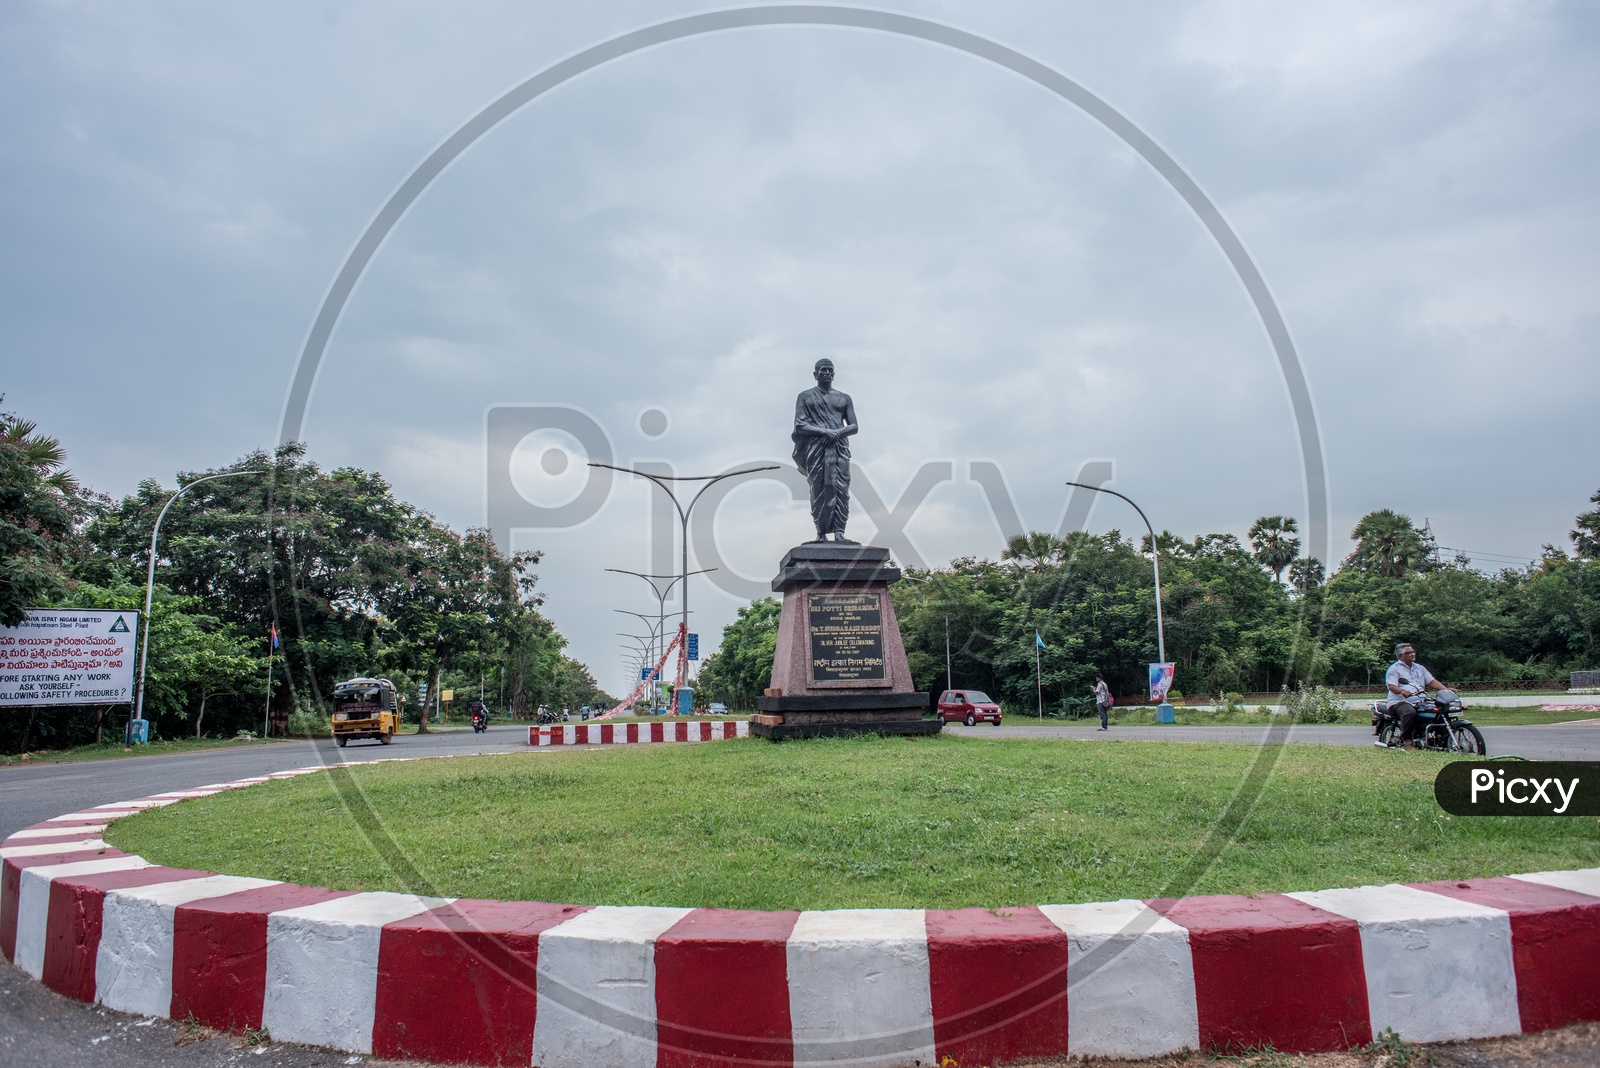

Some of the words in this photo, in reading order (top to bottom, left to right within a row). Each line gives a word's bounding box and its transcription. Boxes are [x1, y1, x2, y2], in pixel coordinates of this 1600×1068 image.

[21, 674, 60, 682] STARTING
[63, 674, 83, 682] ANY
[87, 673, 112, 681] WORK
[19, 683, 35, 691] ASK
[38, 682, 75, 690] YOURSELF
[0, 691, 39, 700] OLLOWING
[41, 690, 72, 699] SAFETY
[74, 689, 119, 698] PROCEDURES
